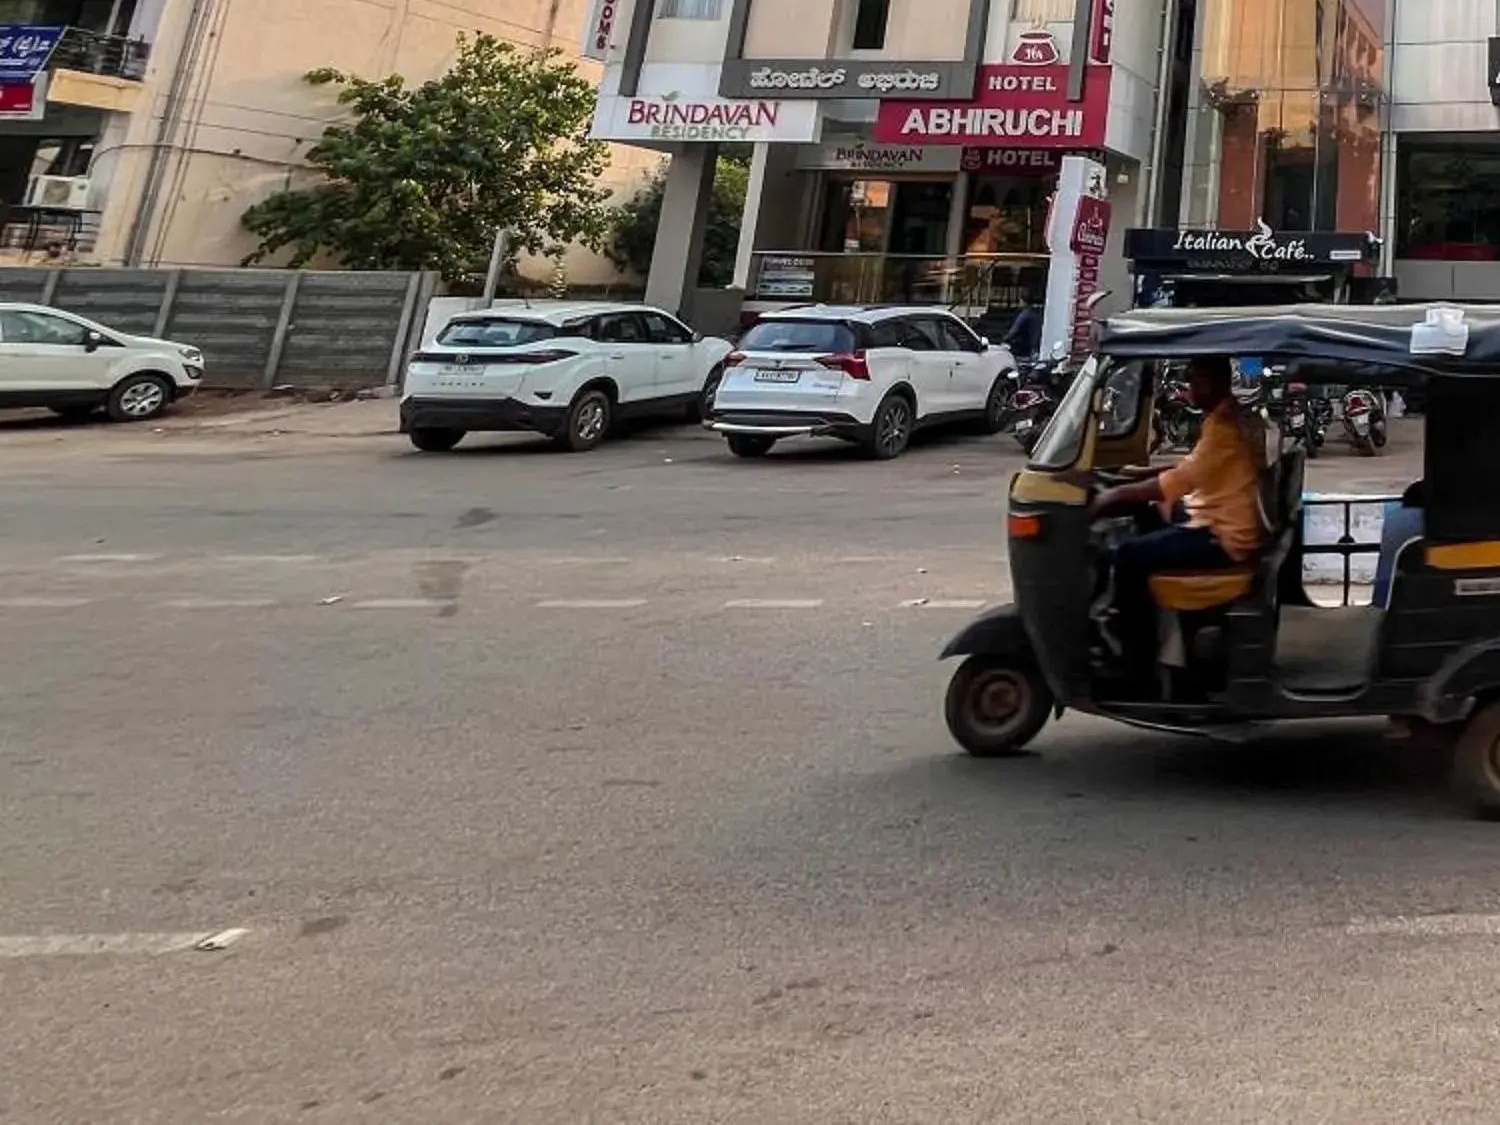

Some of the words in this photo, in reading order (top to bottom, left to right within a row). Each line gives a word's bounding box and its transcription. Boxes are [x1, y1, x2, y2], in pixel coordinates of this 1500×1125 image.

[989, 76, 1056, 91] HOTEL
[627, 100, 781, 126] BRINDAVAN
[901, 108, 1083, 136] ABHIRUCHI
[651, 126, 748, 139] RESIDENCY
[836, 146, 923, 162] BRINDAVAN
[987, 150, 1055, 166] HOTEL
[1173, 230, 1242, 251] Italian
